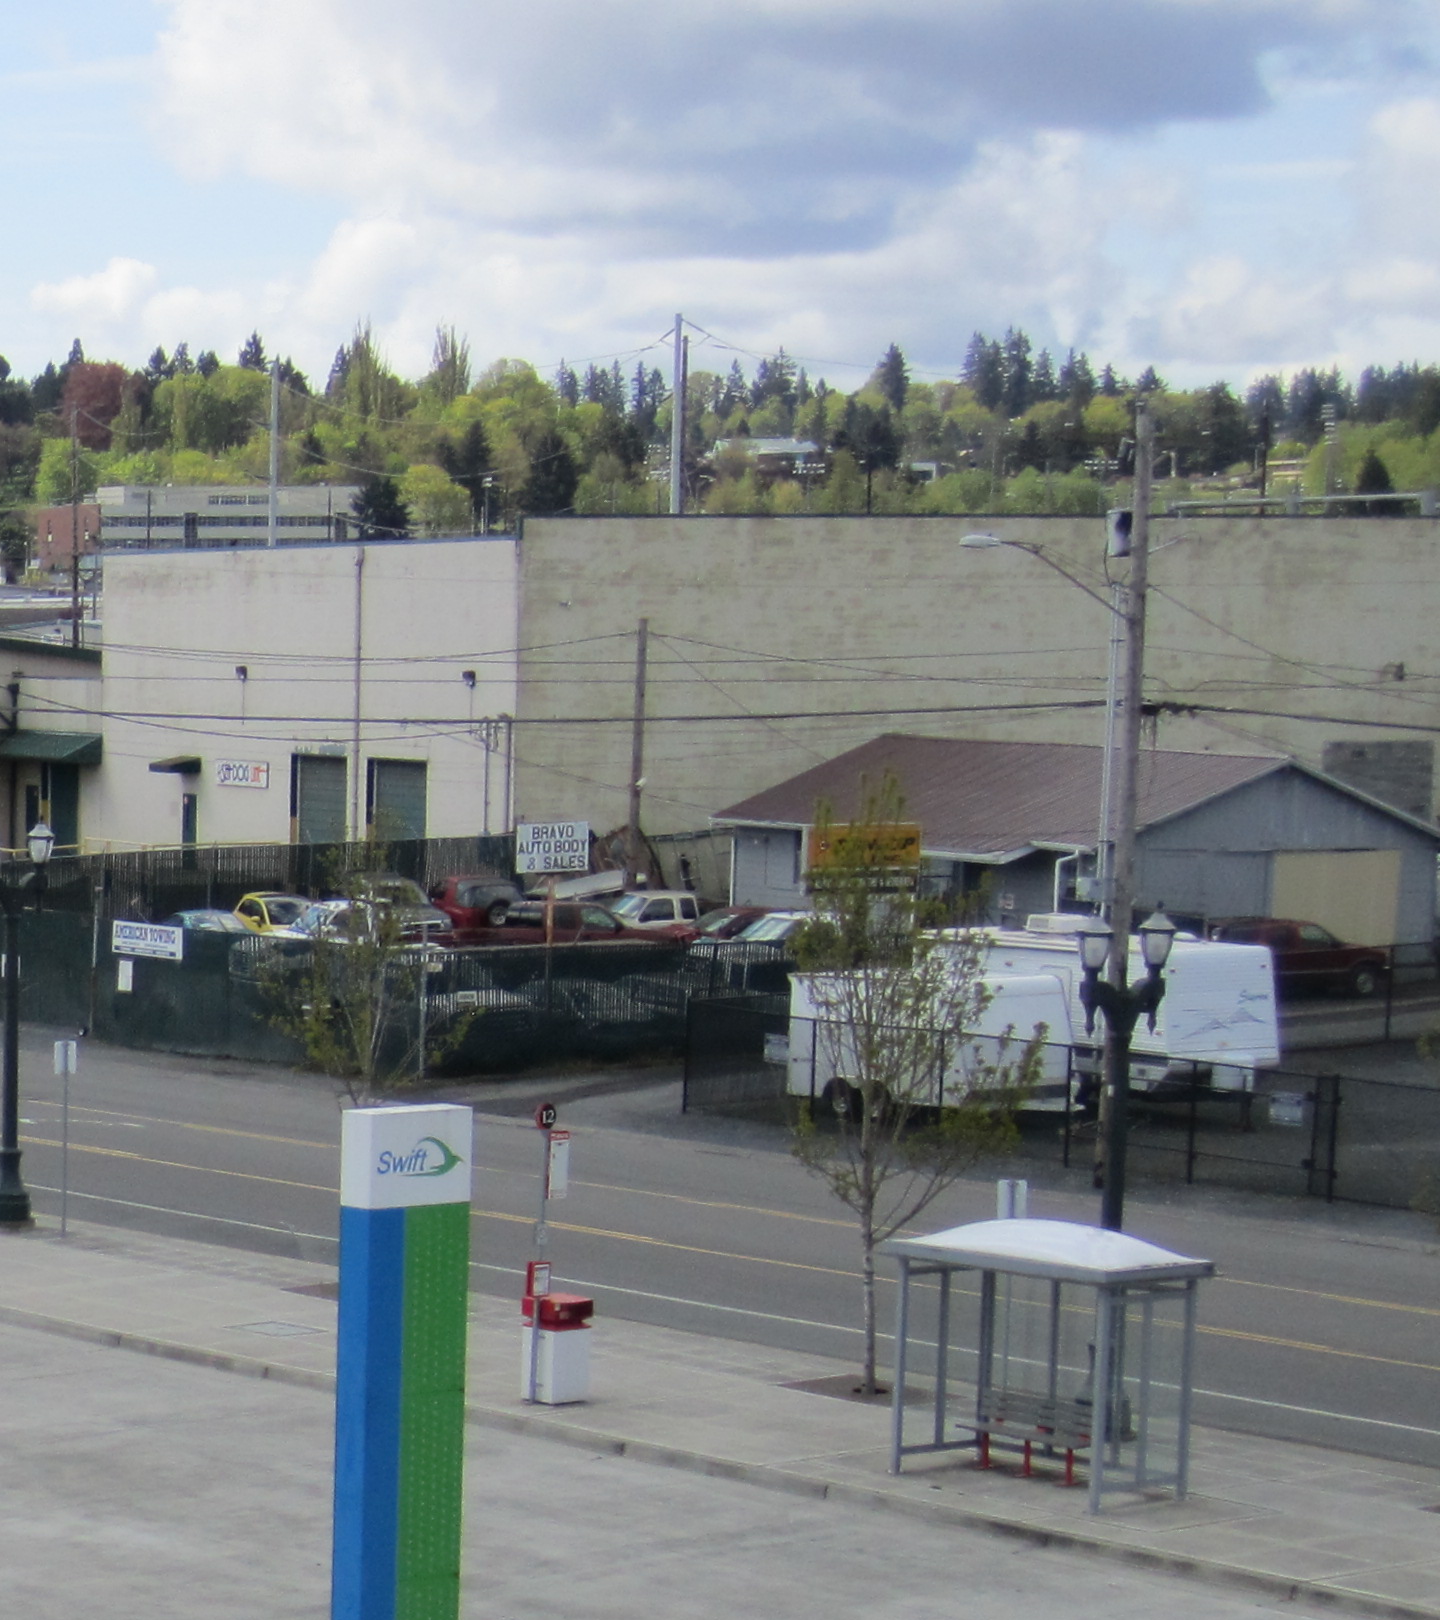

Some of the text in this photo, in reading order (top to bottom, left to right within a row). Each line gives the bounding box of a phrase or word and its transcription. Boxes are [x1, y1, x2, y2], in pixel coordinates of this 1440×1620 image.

[532, 825, 574, 840] BRAVO
[518, 839, 587, 855] AUTO BODY
[543, 855, 586, 870] SALES
[541, 1110, 555, 1125] 12
[377, 1148, 428, 1175] Swift
